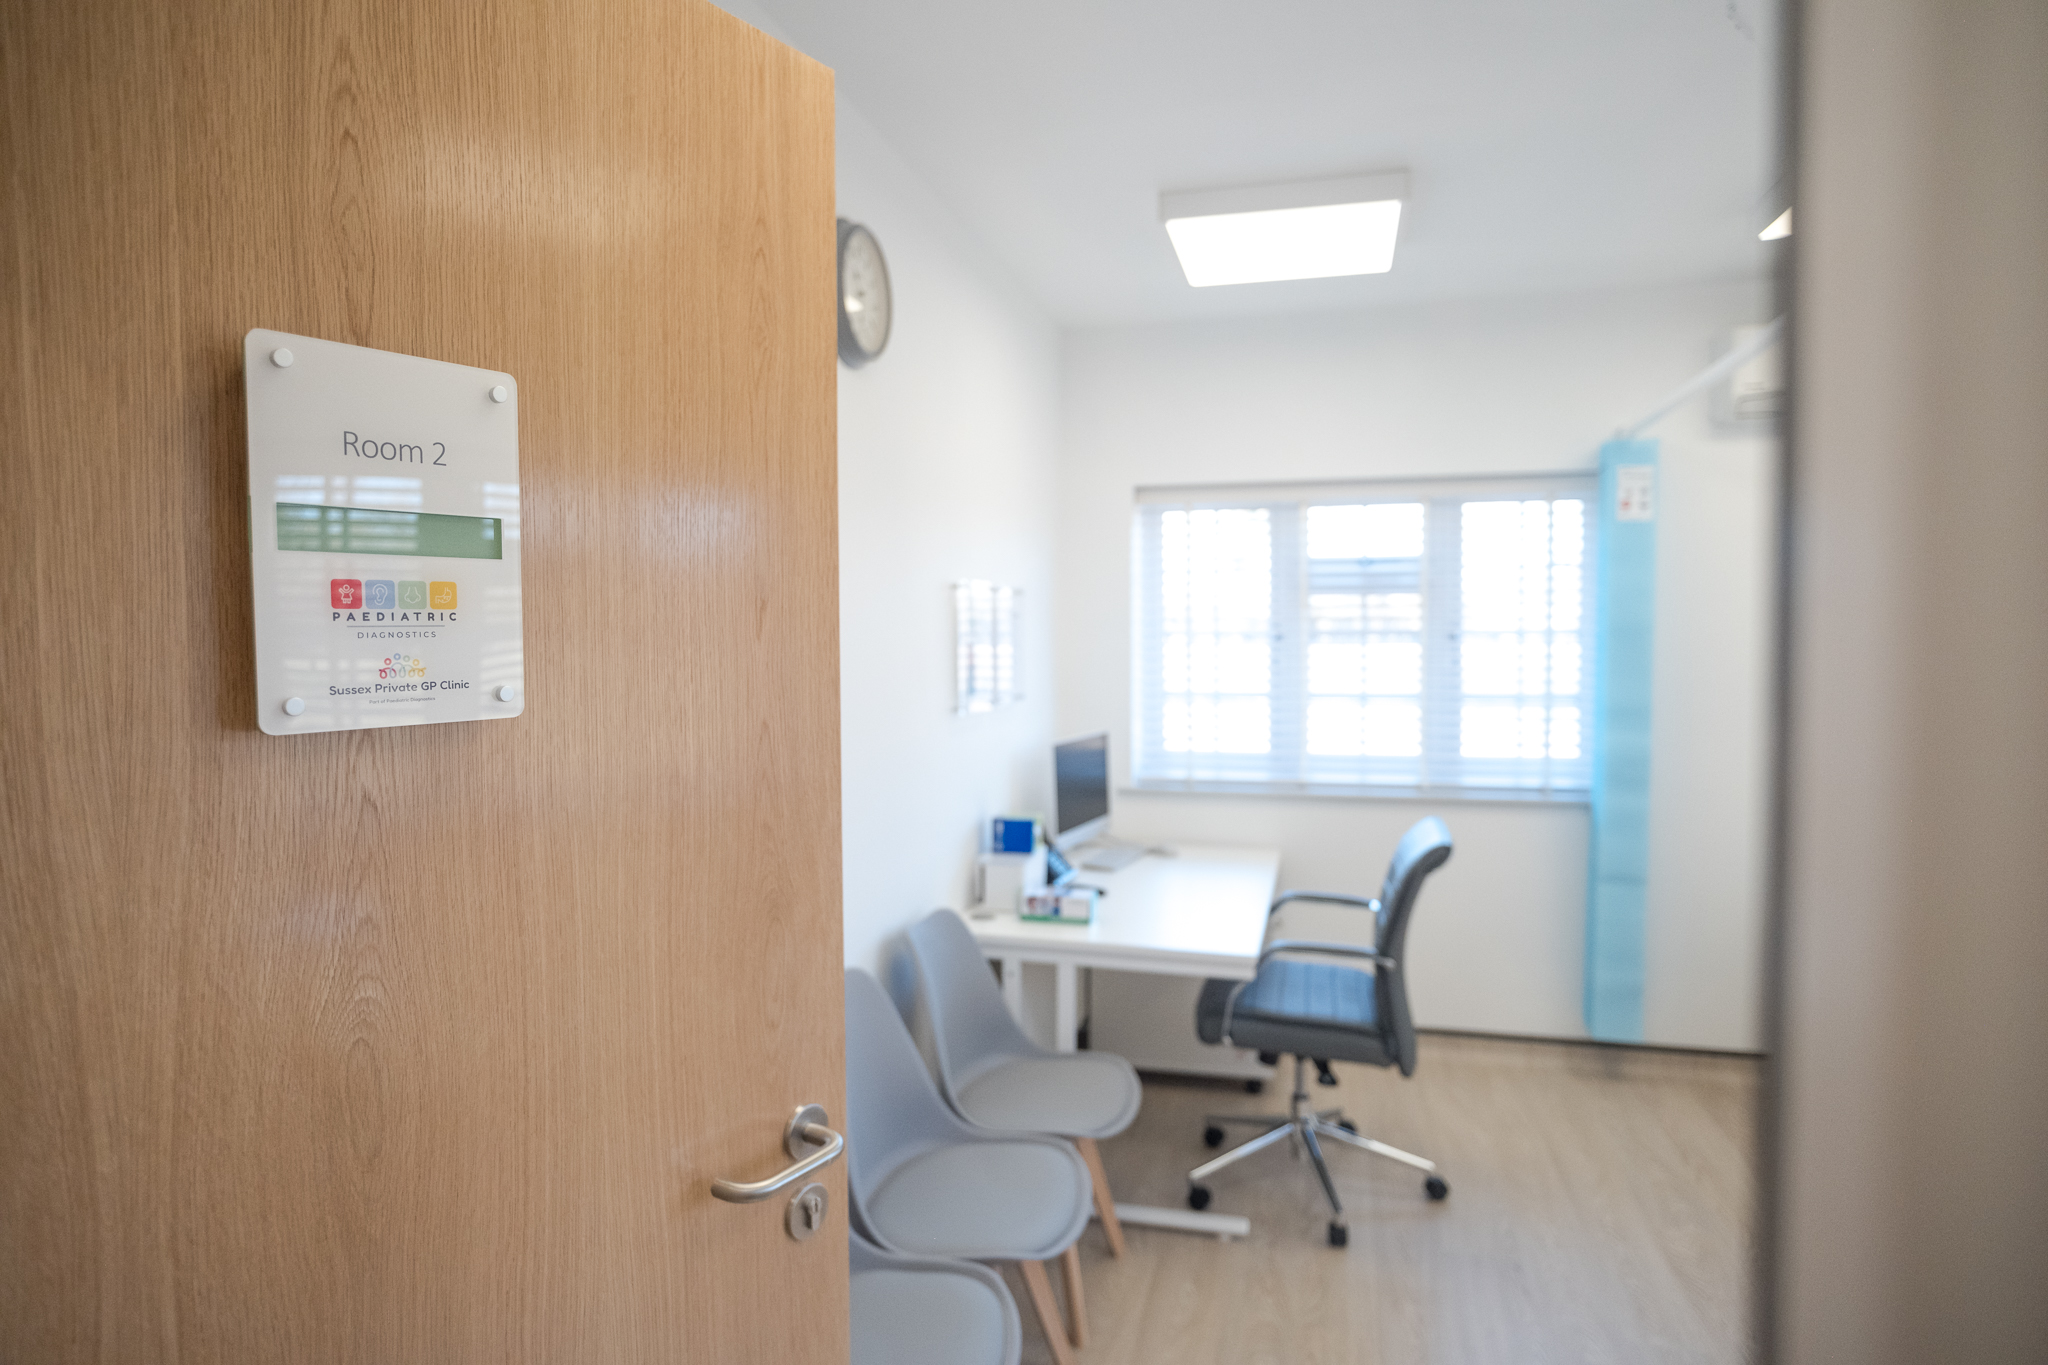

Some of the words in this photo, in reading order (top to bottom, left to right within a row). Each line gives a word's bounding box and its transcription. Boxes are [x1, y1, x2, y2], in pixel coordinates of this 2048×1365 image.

[343, 430, 423, 464] Room
[432, 442, 447, 467] 2
[332, 611, 457, 622] PAEDIATRIC
[357, 630, 437, 639] DIAGNOSTICS
[329, 685, 372, 696] Sussex
[374, 683, 418, 693] Private
[420, 681, 437, 691] GP
[439, 679, 470, 690] Clinic
